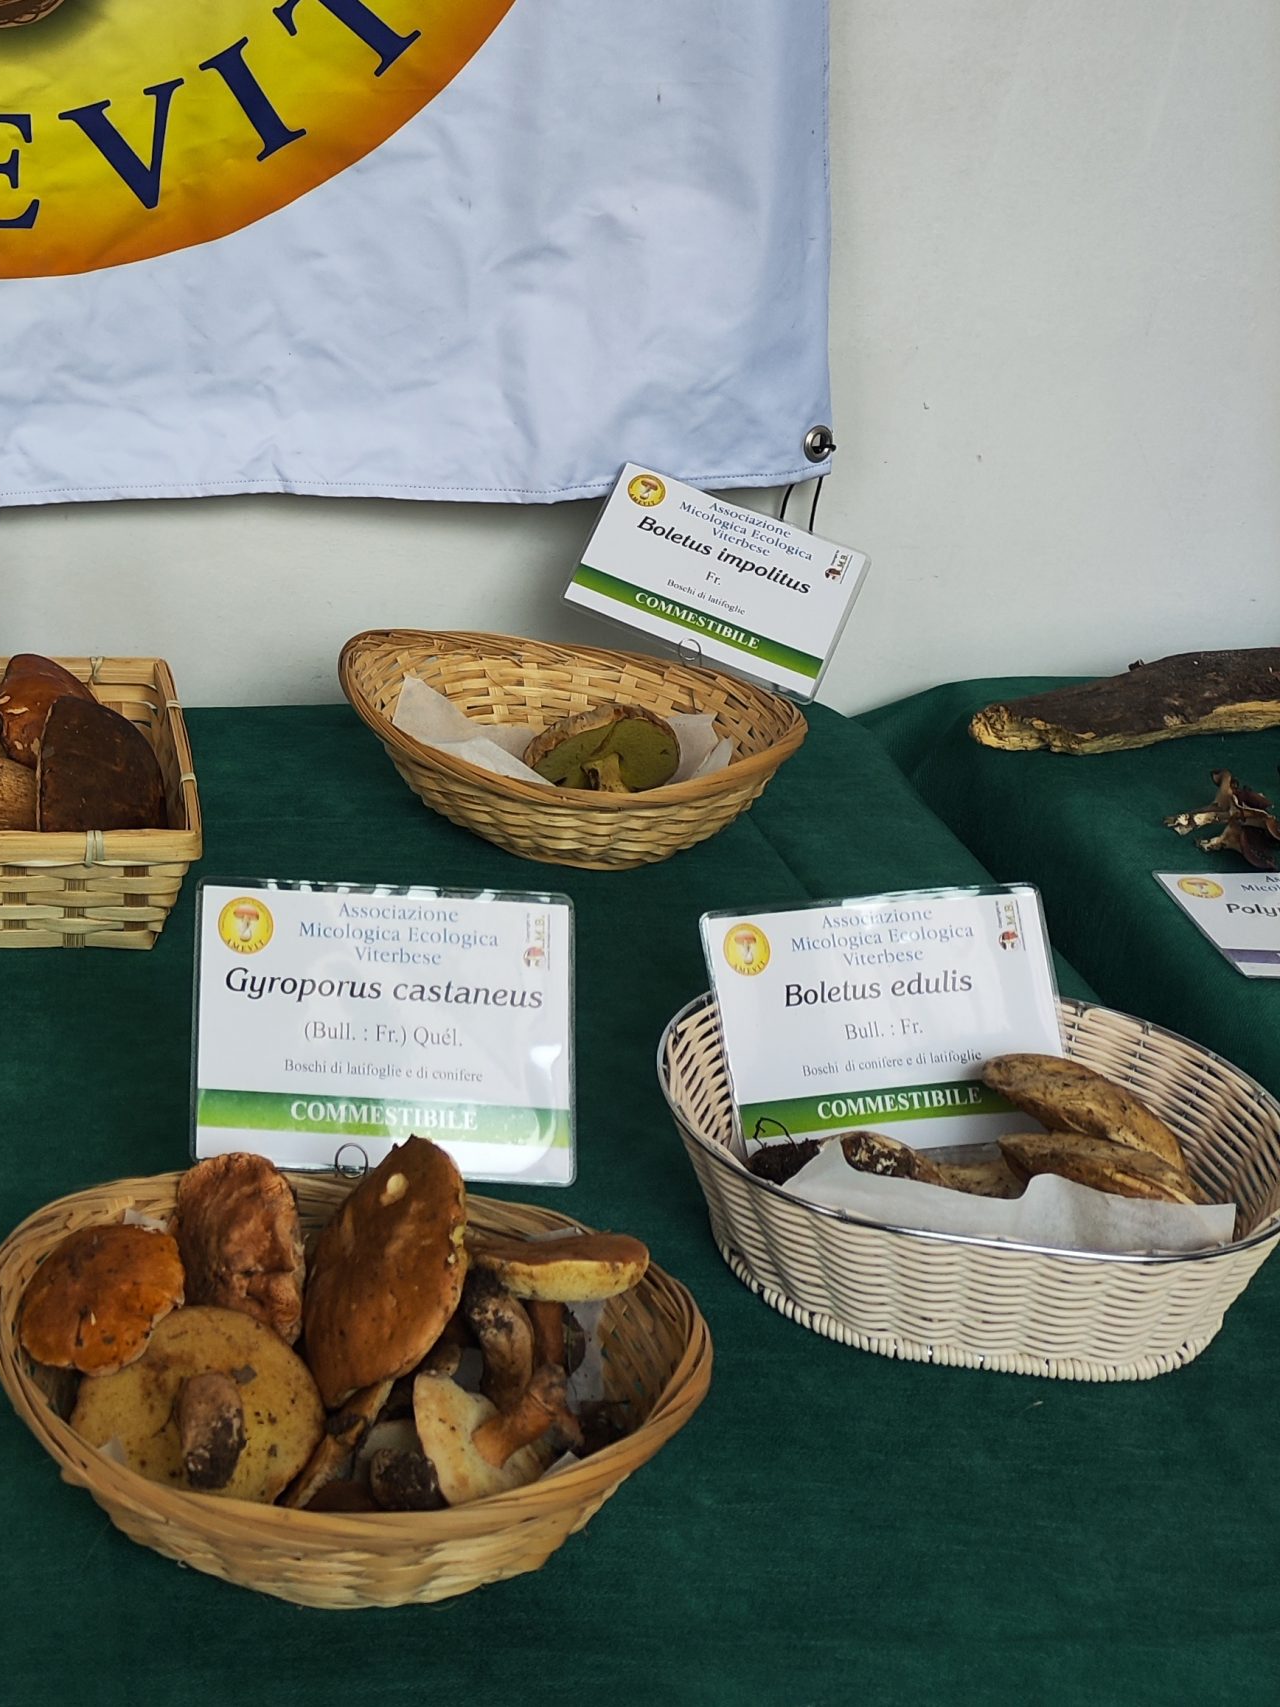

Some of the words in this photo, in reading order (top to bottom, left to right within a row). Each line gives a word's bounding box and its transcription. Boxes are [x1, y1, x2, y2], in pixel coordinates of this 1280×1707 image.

[679, 501, 747, 536] Micologica
[751, 528, 813, 561] Ecologica
[709, 501, 791, 538] Associazione
[636, 515, 713, 556] Boletus
[717, 548, 812, 594] impolitus
[712, 528, 770, 557] Viterbese
[705, 570, 721, 585] Fr.
[667, 579, 696, 596] Boschi
[697, 590, 706, 600] di
[707, 593, 746, 615] latifoglie
[635, 591, 760, 649] COMMESTIBILE
[338, 902, 459, 923] Associazione
[822, 908, 933, 930] Associazione
[1226, 904, 1280, 916] Poly
[299, 921, 400, 944] Micologica
[408, 926, 498, 948] Ecologica
[791, 930, 882, 953] Micologica
[889, 923, 974, 946] Ecologica
[355, 946, 441, 966] Viterbese
[843, 947, 924, 967] Viterbese
[225, 966, 381, 1003] Gyroporus
[393, 978, 543, 1009] castaneus
[784, 978, 881, 1007] Boletus
[891, 969, 973, 997] edulis
[304, 1021, 356, 1041] (Bull.
[376, 1024, 407, 1047] Fr.)
[414, 1026, 463, 1047] Quél.
[845, 1020, 884, 1041] Bull.
[900, 1018, 923, 1036] Fr.
[284, 1059, 327, 1074] Boschi
[330, 1060, 342, 1075] di
[347, 1061, 402, 1079] latifoglie
[406, 1068, 413, 1078] e
[416, 1065, 428, 1080] di
[432, 1066, 483, 1083] conifere
[802, 1061, 839, 1077] Boschi
[845, 1058, 856, 1072] di
[859, 1055, 903, 1071] conifere
[906, 1058, 913, 1067] e
[916, 1052, 926, 1065] di
[930, 1049, 982, 1066] latifoglie
[290, 1100, 478, 1130] COMMESTIBILE
[817, 1086, 982, 1120] COMMESTIBILE
